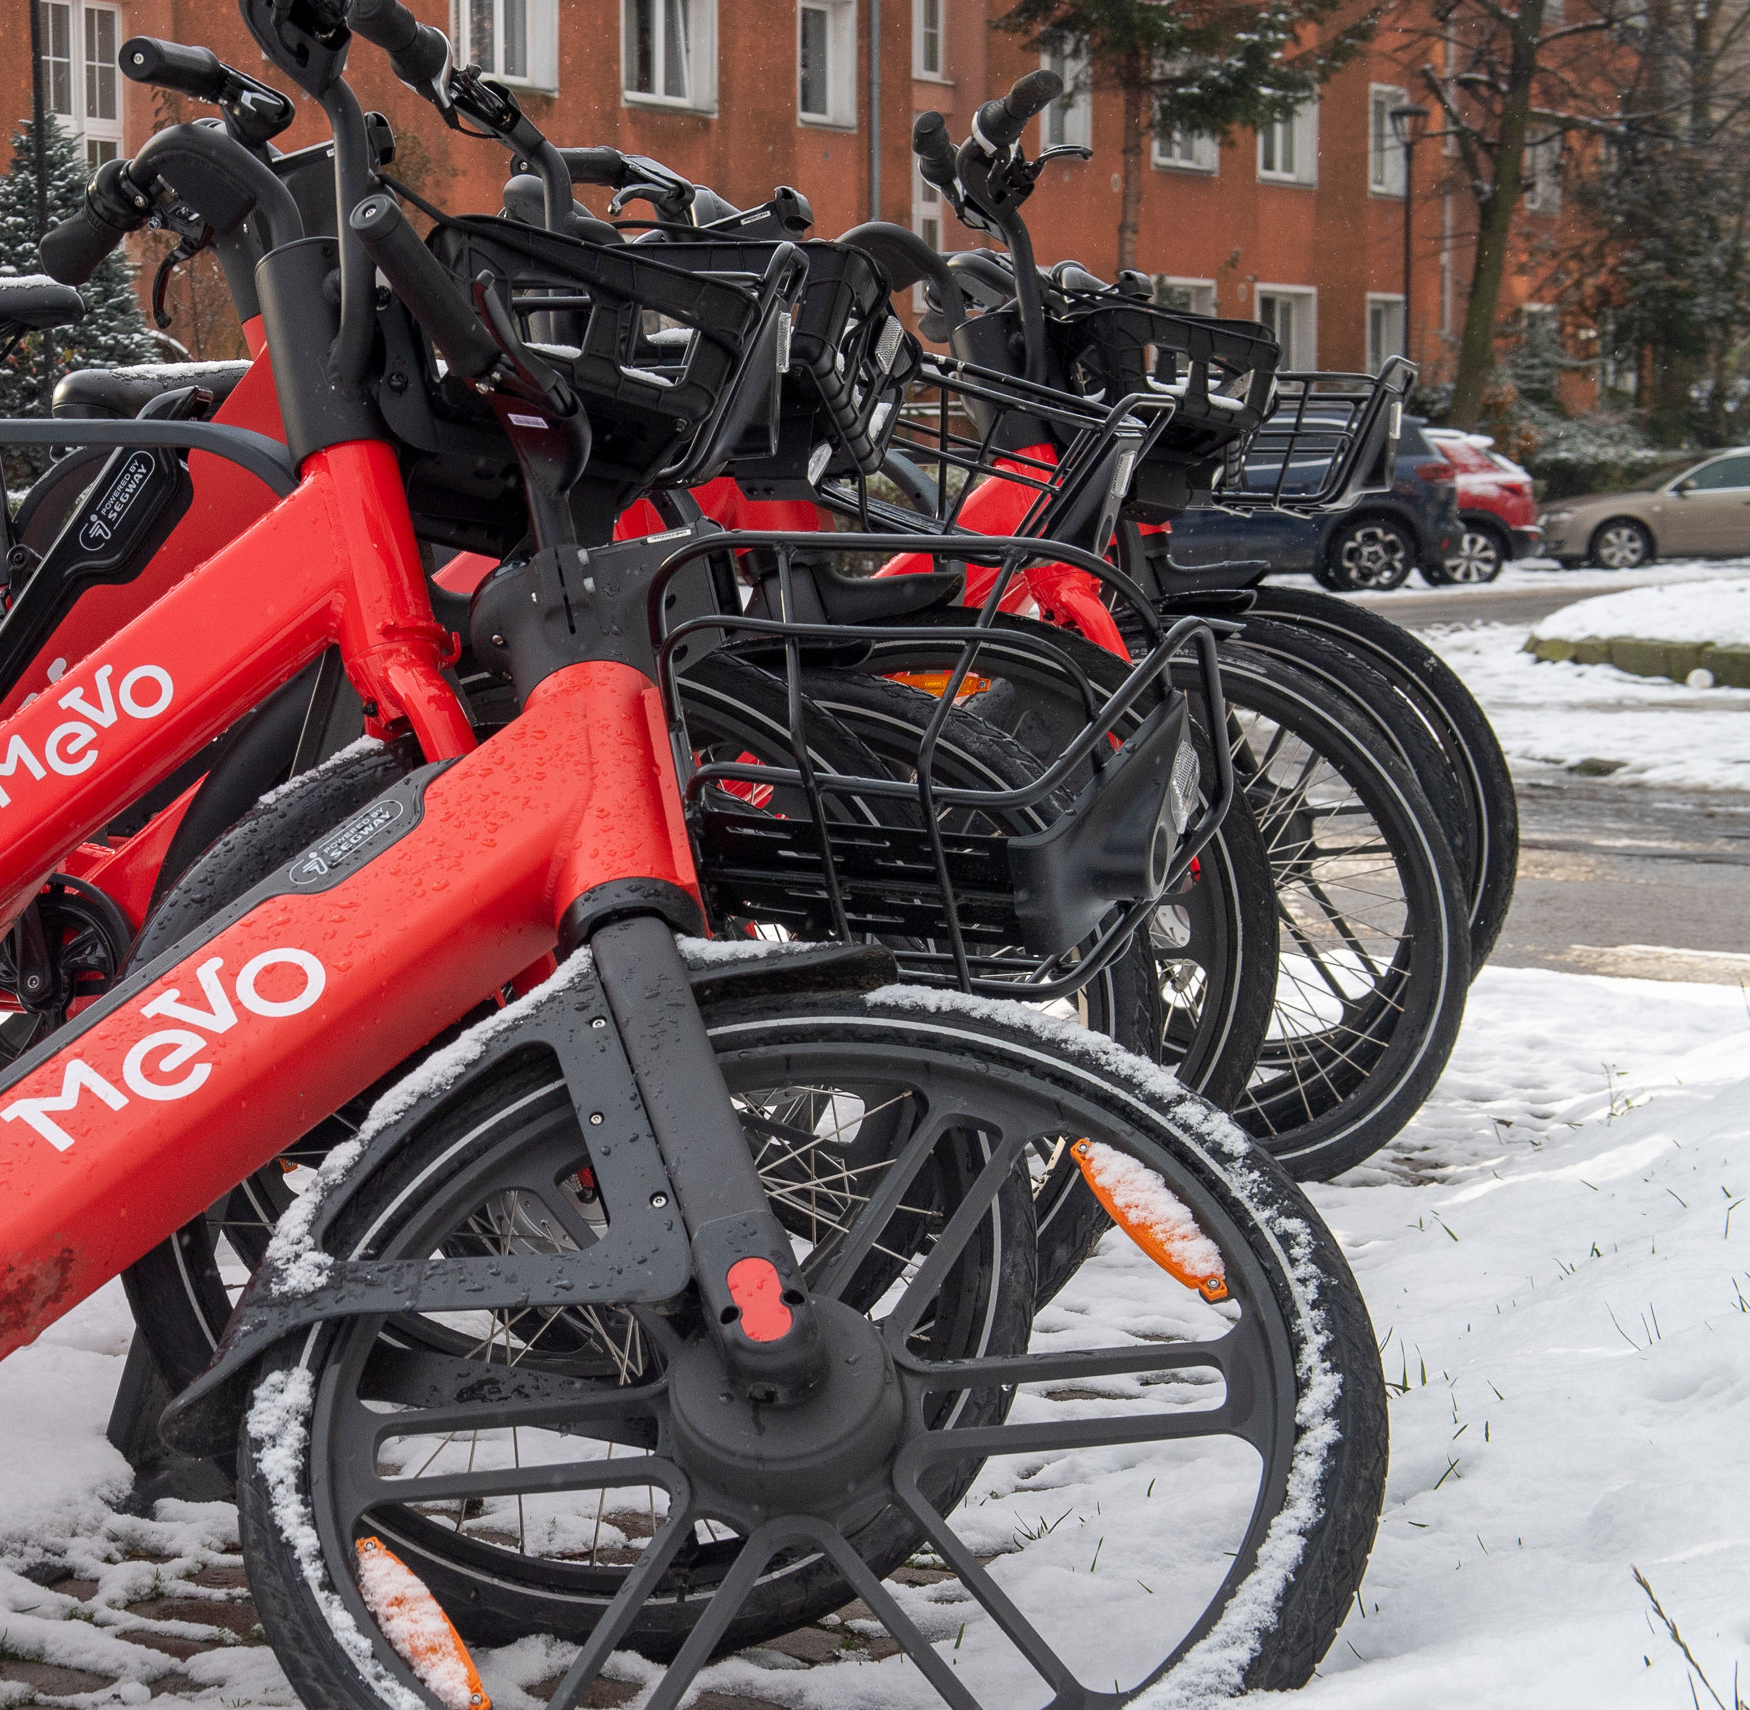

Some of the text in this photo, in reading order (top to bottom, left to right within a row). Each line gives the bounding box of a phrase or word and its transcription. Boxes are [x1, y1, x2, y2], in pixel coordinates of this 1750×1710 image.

[100, 459, 140, 516] POWERED BY
[107, 464, 147, 521] SEGWAY
[323, 806, 384, 854] POWERED BY
[330, 810, 391, 859] SEGWAY
